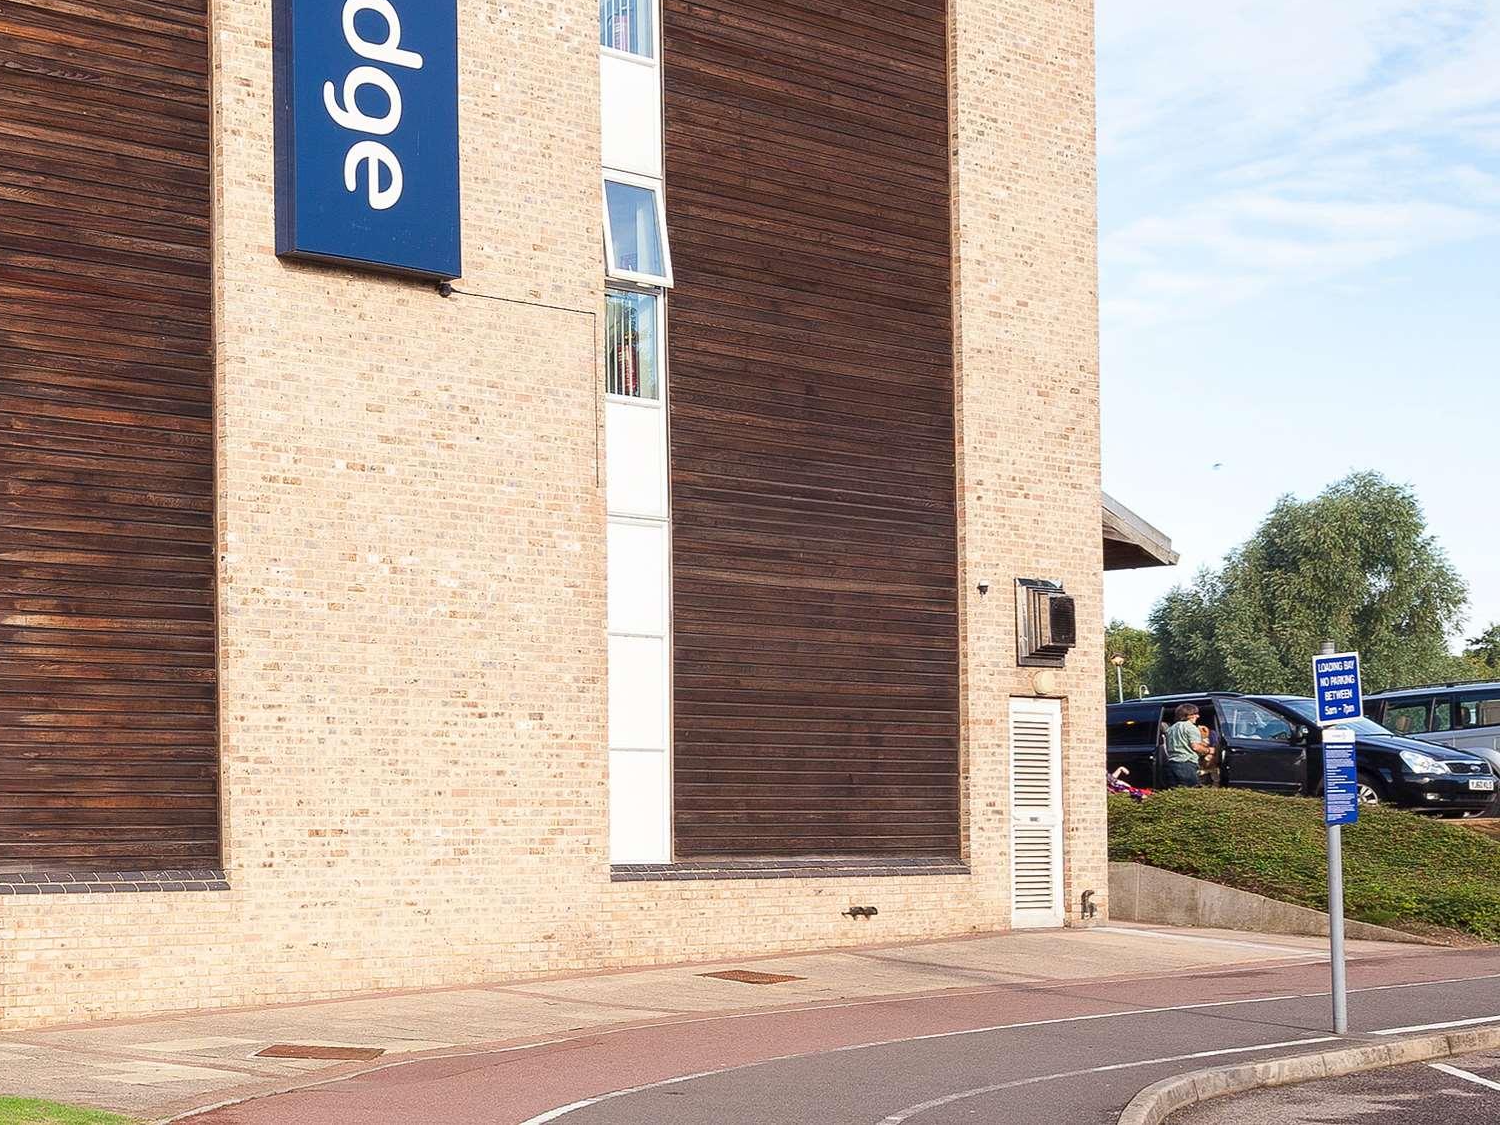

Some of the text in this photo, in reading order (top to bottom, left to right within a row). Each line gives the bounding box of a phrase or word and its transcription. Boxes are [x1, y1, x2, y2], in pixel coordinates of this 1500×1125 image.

[1318, 660, 1355, 673] LOADING BAY
[1320, 674, 1355, 687] NO PARKING
[1324, 689, 1353, 701] BETWEEN
[1343, 703, 1355, 715] 7pm
